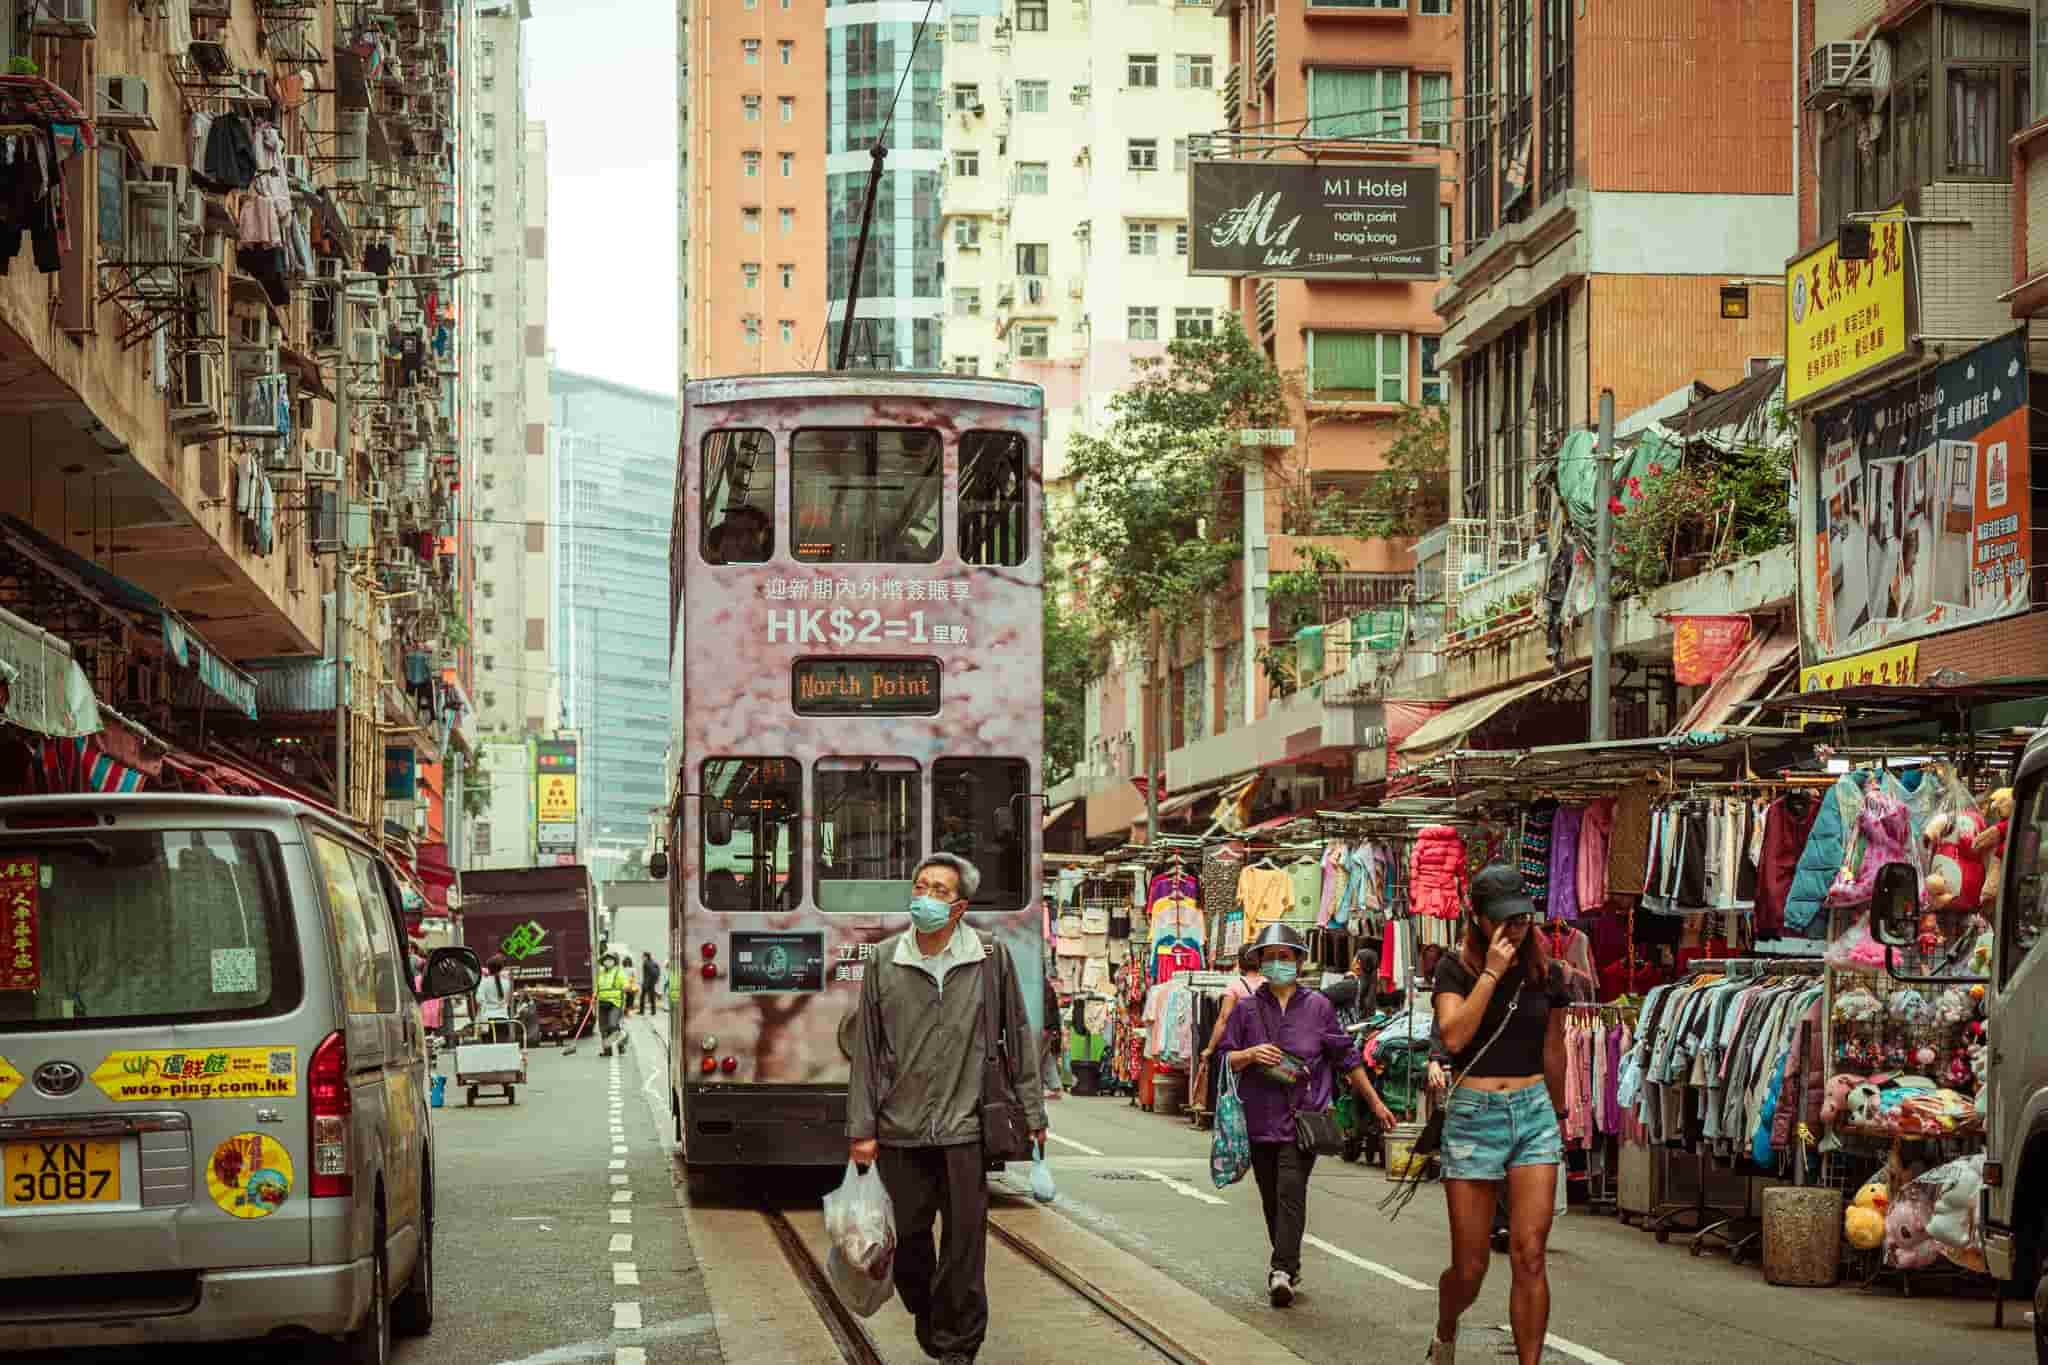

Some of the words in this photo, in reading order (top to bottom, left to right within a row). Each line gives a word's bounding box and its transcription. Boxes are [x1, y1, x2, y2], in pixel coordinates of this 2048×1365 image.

[1324, 179, 1350, 196] M1
[1357, 179, 1408, 198] Hotel
[1333, 211, 1365, 223] north
[1366, 212, 1398, 225] point
[1333, 231, 1365, 245] hong
[1366, 231, 1398, 245] kong
[767, 608, 930, 645] HK$2=1
[931, 624, 968, 646] 里數
[799, 674, 862, 698] North
[871, 673, 931, 698] Point
[121, 1079, 289, 1097] woo-ping.com.hk
[39, 1143, 87, 1172] XN
[14, 1170, 112, 1202] 3087
